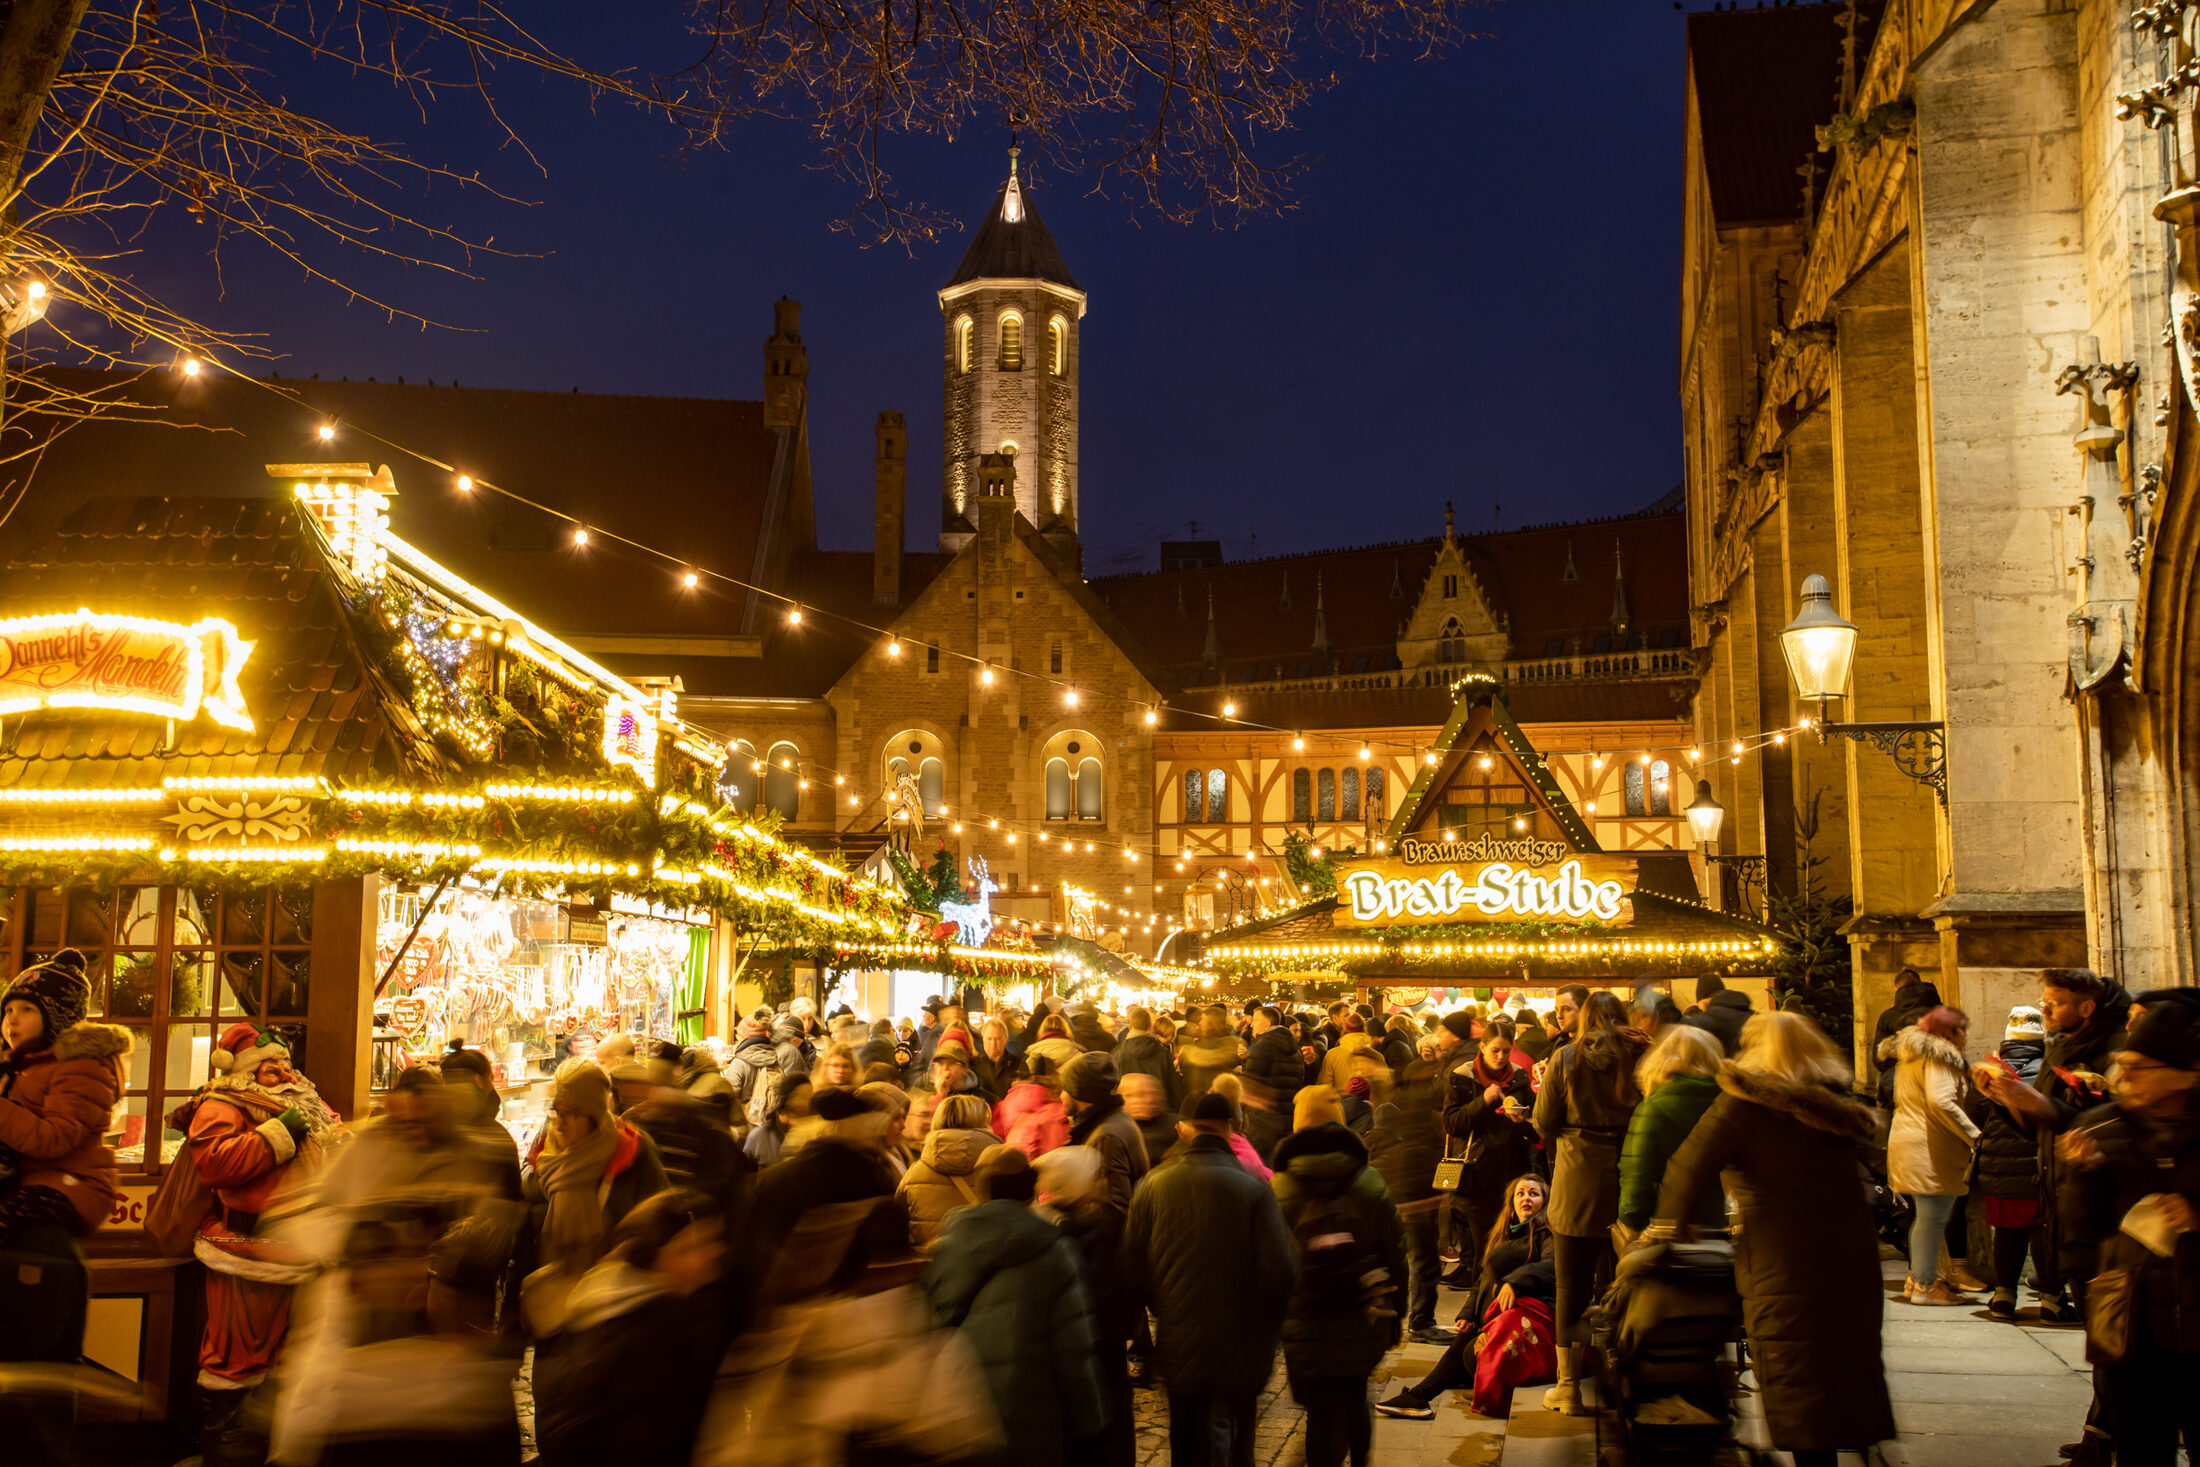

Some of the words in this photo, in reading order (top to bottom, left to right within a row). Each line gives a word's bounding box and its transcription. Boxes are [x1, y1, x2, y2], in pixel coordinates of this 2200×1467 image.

[48, 627, 190, 697] Mandeln
[1402, 831, 1567, 867] Braunschweiger
[1346, 860, 1622, 920] Brat-Stube
